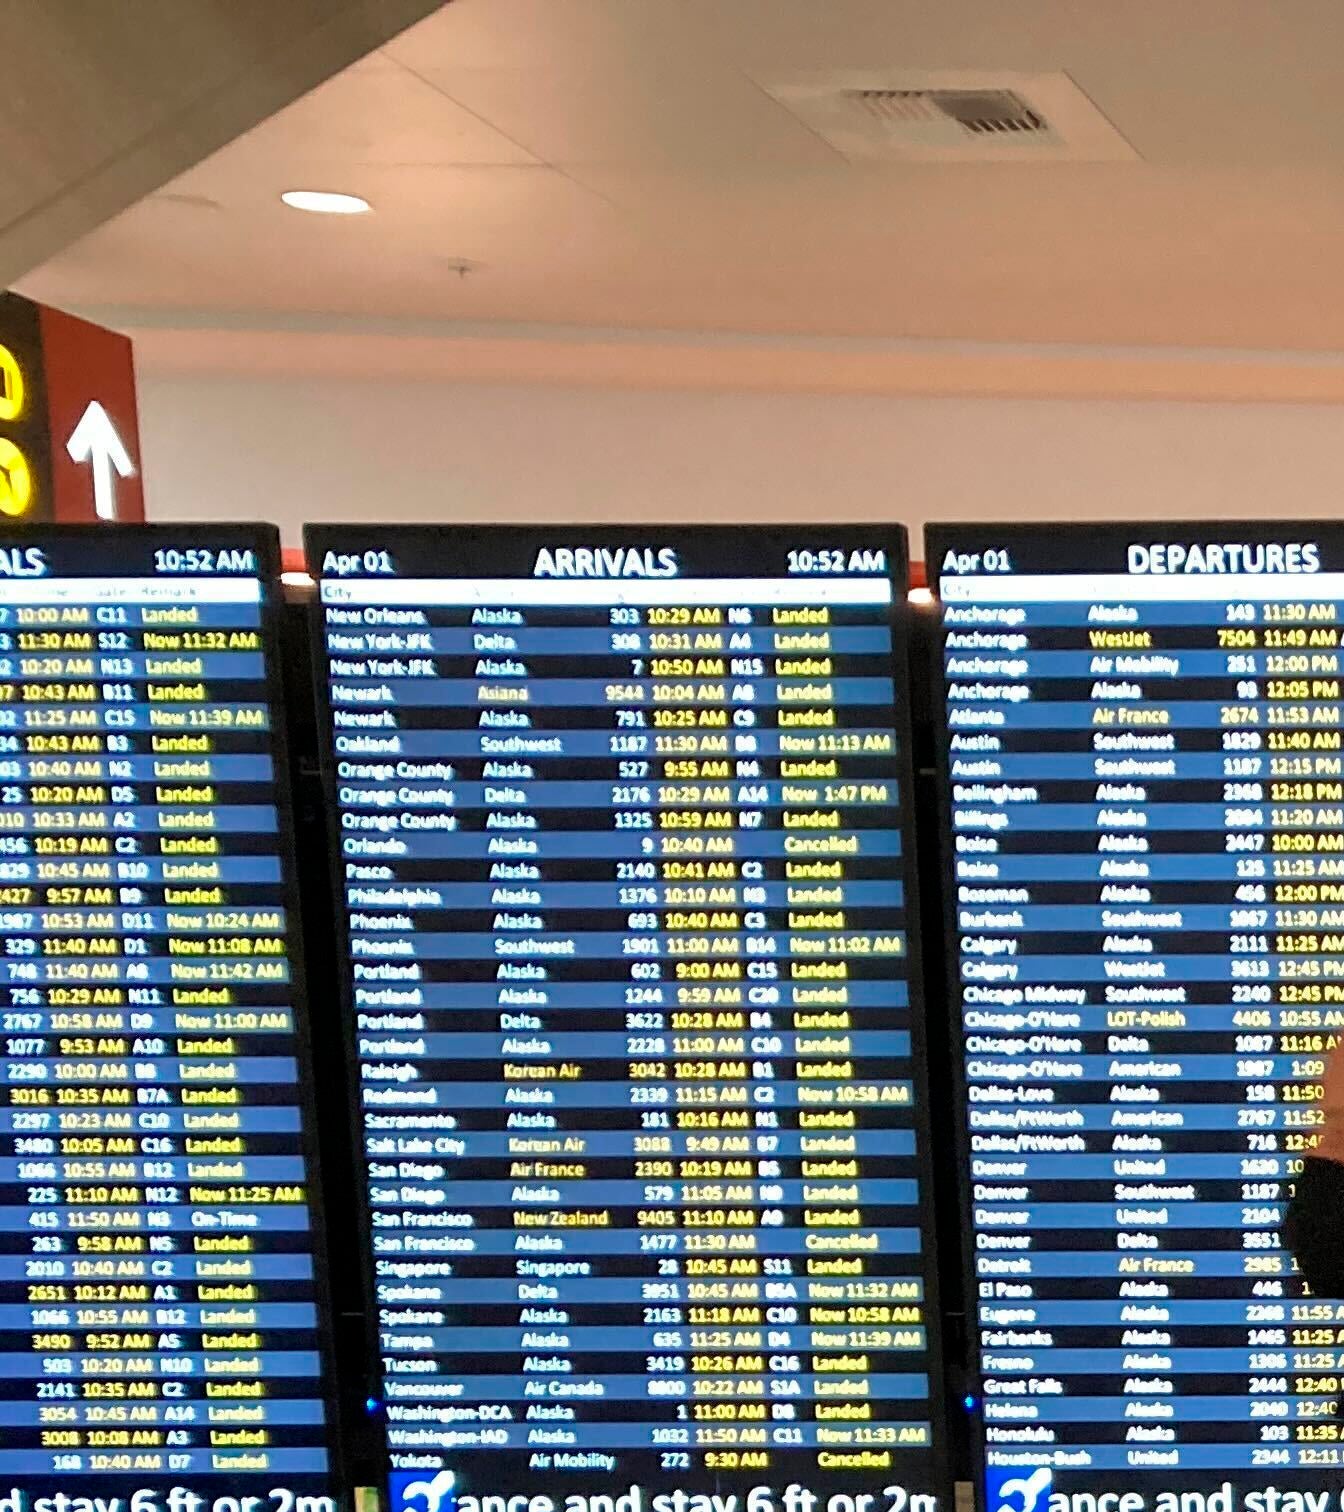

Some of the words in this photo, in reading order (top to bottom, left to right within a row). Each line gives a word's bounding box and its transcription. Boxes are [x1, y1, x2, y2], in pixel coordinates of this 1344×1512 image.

[155, 550, 213, 571] 10:52
[217, 550, 253, 571] AM
[323, 551, 360, 575] Apr
[364, 551, 394, 572] 01
[534, 548, 677, 576] ARRIVALS
[788, 551, 844, 572] 10:52
[848, 551, 884, 571] AM
[943, 551, 980, 574] Apr
[984, 550, 1010, 570] 01
[1127, 545, 1319, 572] DEPARTURES
[326, 608, 362, 624] New
[364, 608, 425, 624] Orleans
[472, 608, 523, 624] Alaska
[693, 608, 720, 623] AM
[773, 607, 828, 623] Landed
[63, 633, 92, 648] AM
[144, 633, 180, 648] Now
[229, 633, 257, 648] AM
[1309, 630, 1336, 645] AM
[119, 1285, 148, 1299] AM
[198, 1284, 254, 1299] Landed
[529, 1453, 558, 1467] Air
[555, 1453, 614, 1470] Mobility
[661, 1453, 689, 1467] 272
[705, 1453, 739, 1467] 9:30
[740, 1453, 768, 1466] AM
[818, 1451, 890, 1466] Cancelled
